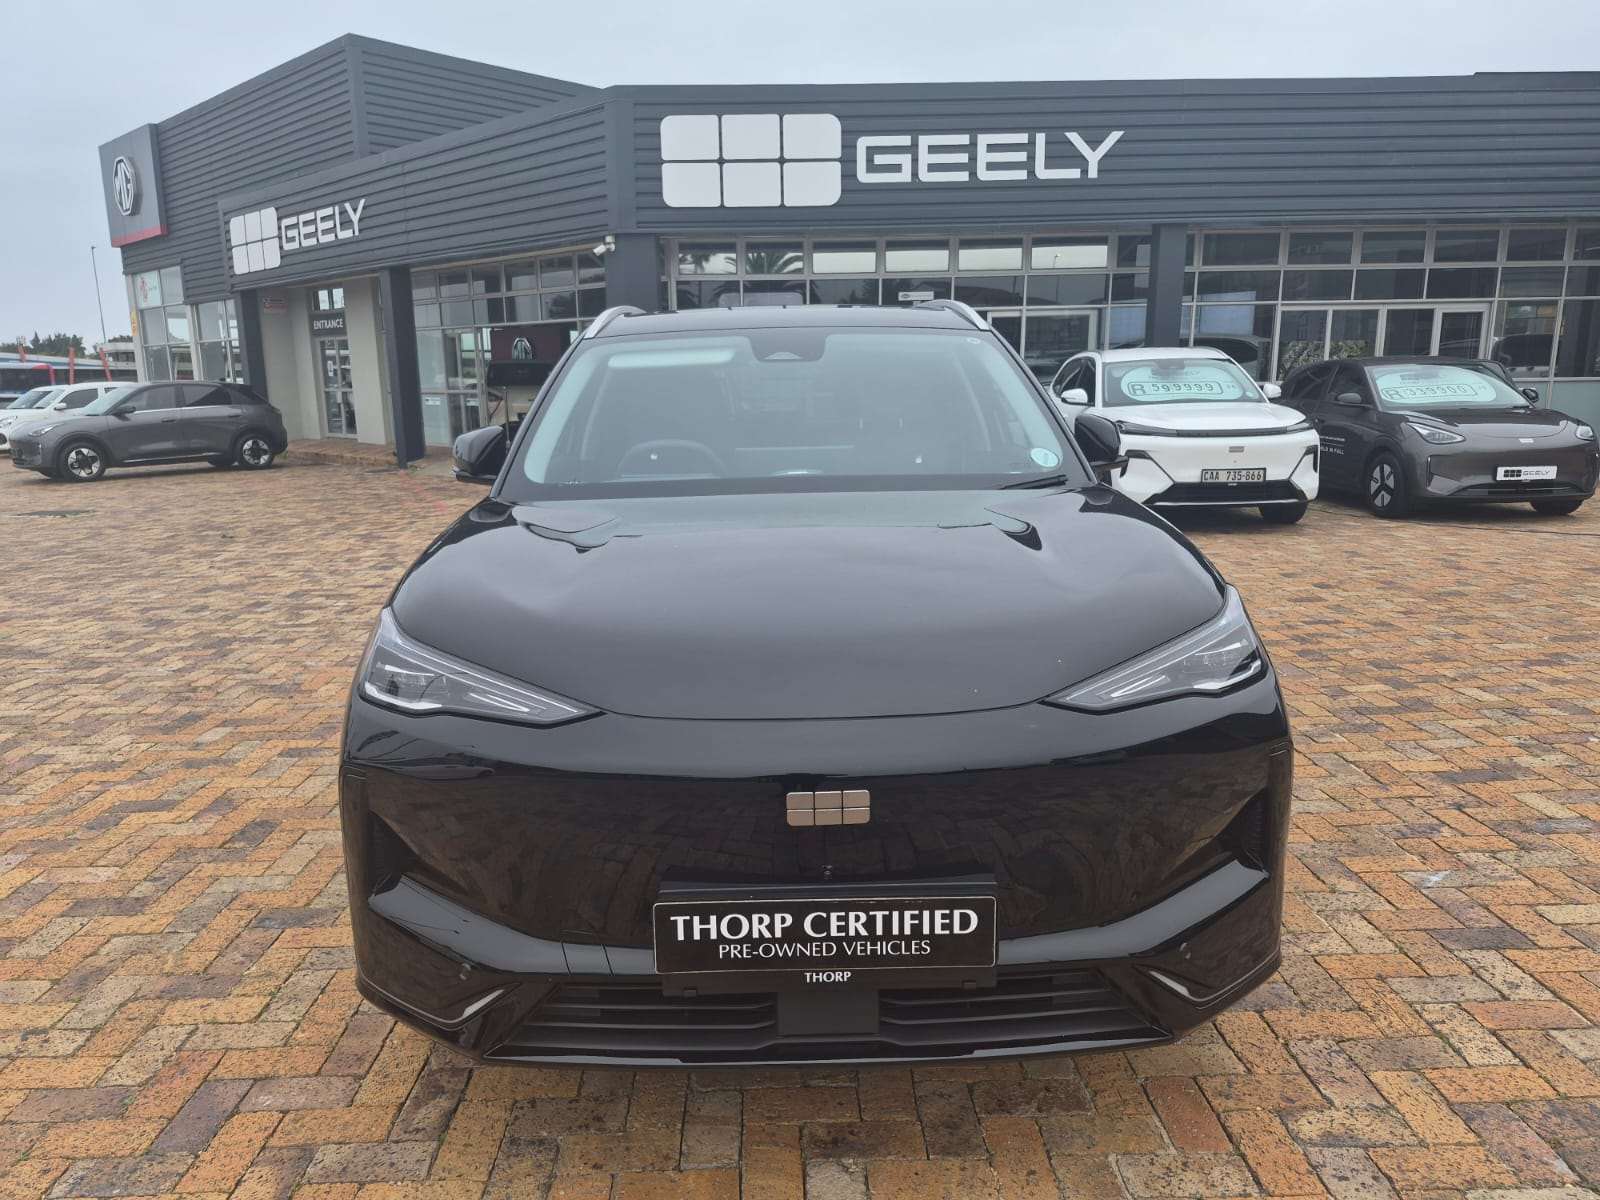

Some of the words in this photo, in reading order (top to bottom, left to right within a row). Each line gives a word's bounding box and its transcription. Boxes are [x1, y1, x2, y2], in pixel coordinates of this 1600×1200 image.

[856, 130, 1125, 184] GEELY
[114, 158, 132, 212] MG
[281, 198, 366, 251] GEELY
[313, 319, 344, 330] ENTRANCE
[1203, 471, 1220, 481] CAA
[670, 913, 793, 941] THORP
[803, 909, 979, 938] CERTIFIED
[718, 942, 837, 960] PRE-OWNED
[842, 940, 931, 956] VEHICLES
[803, 971, 852, 983] THORP
